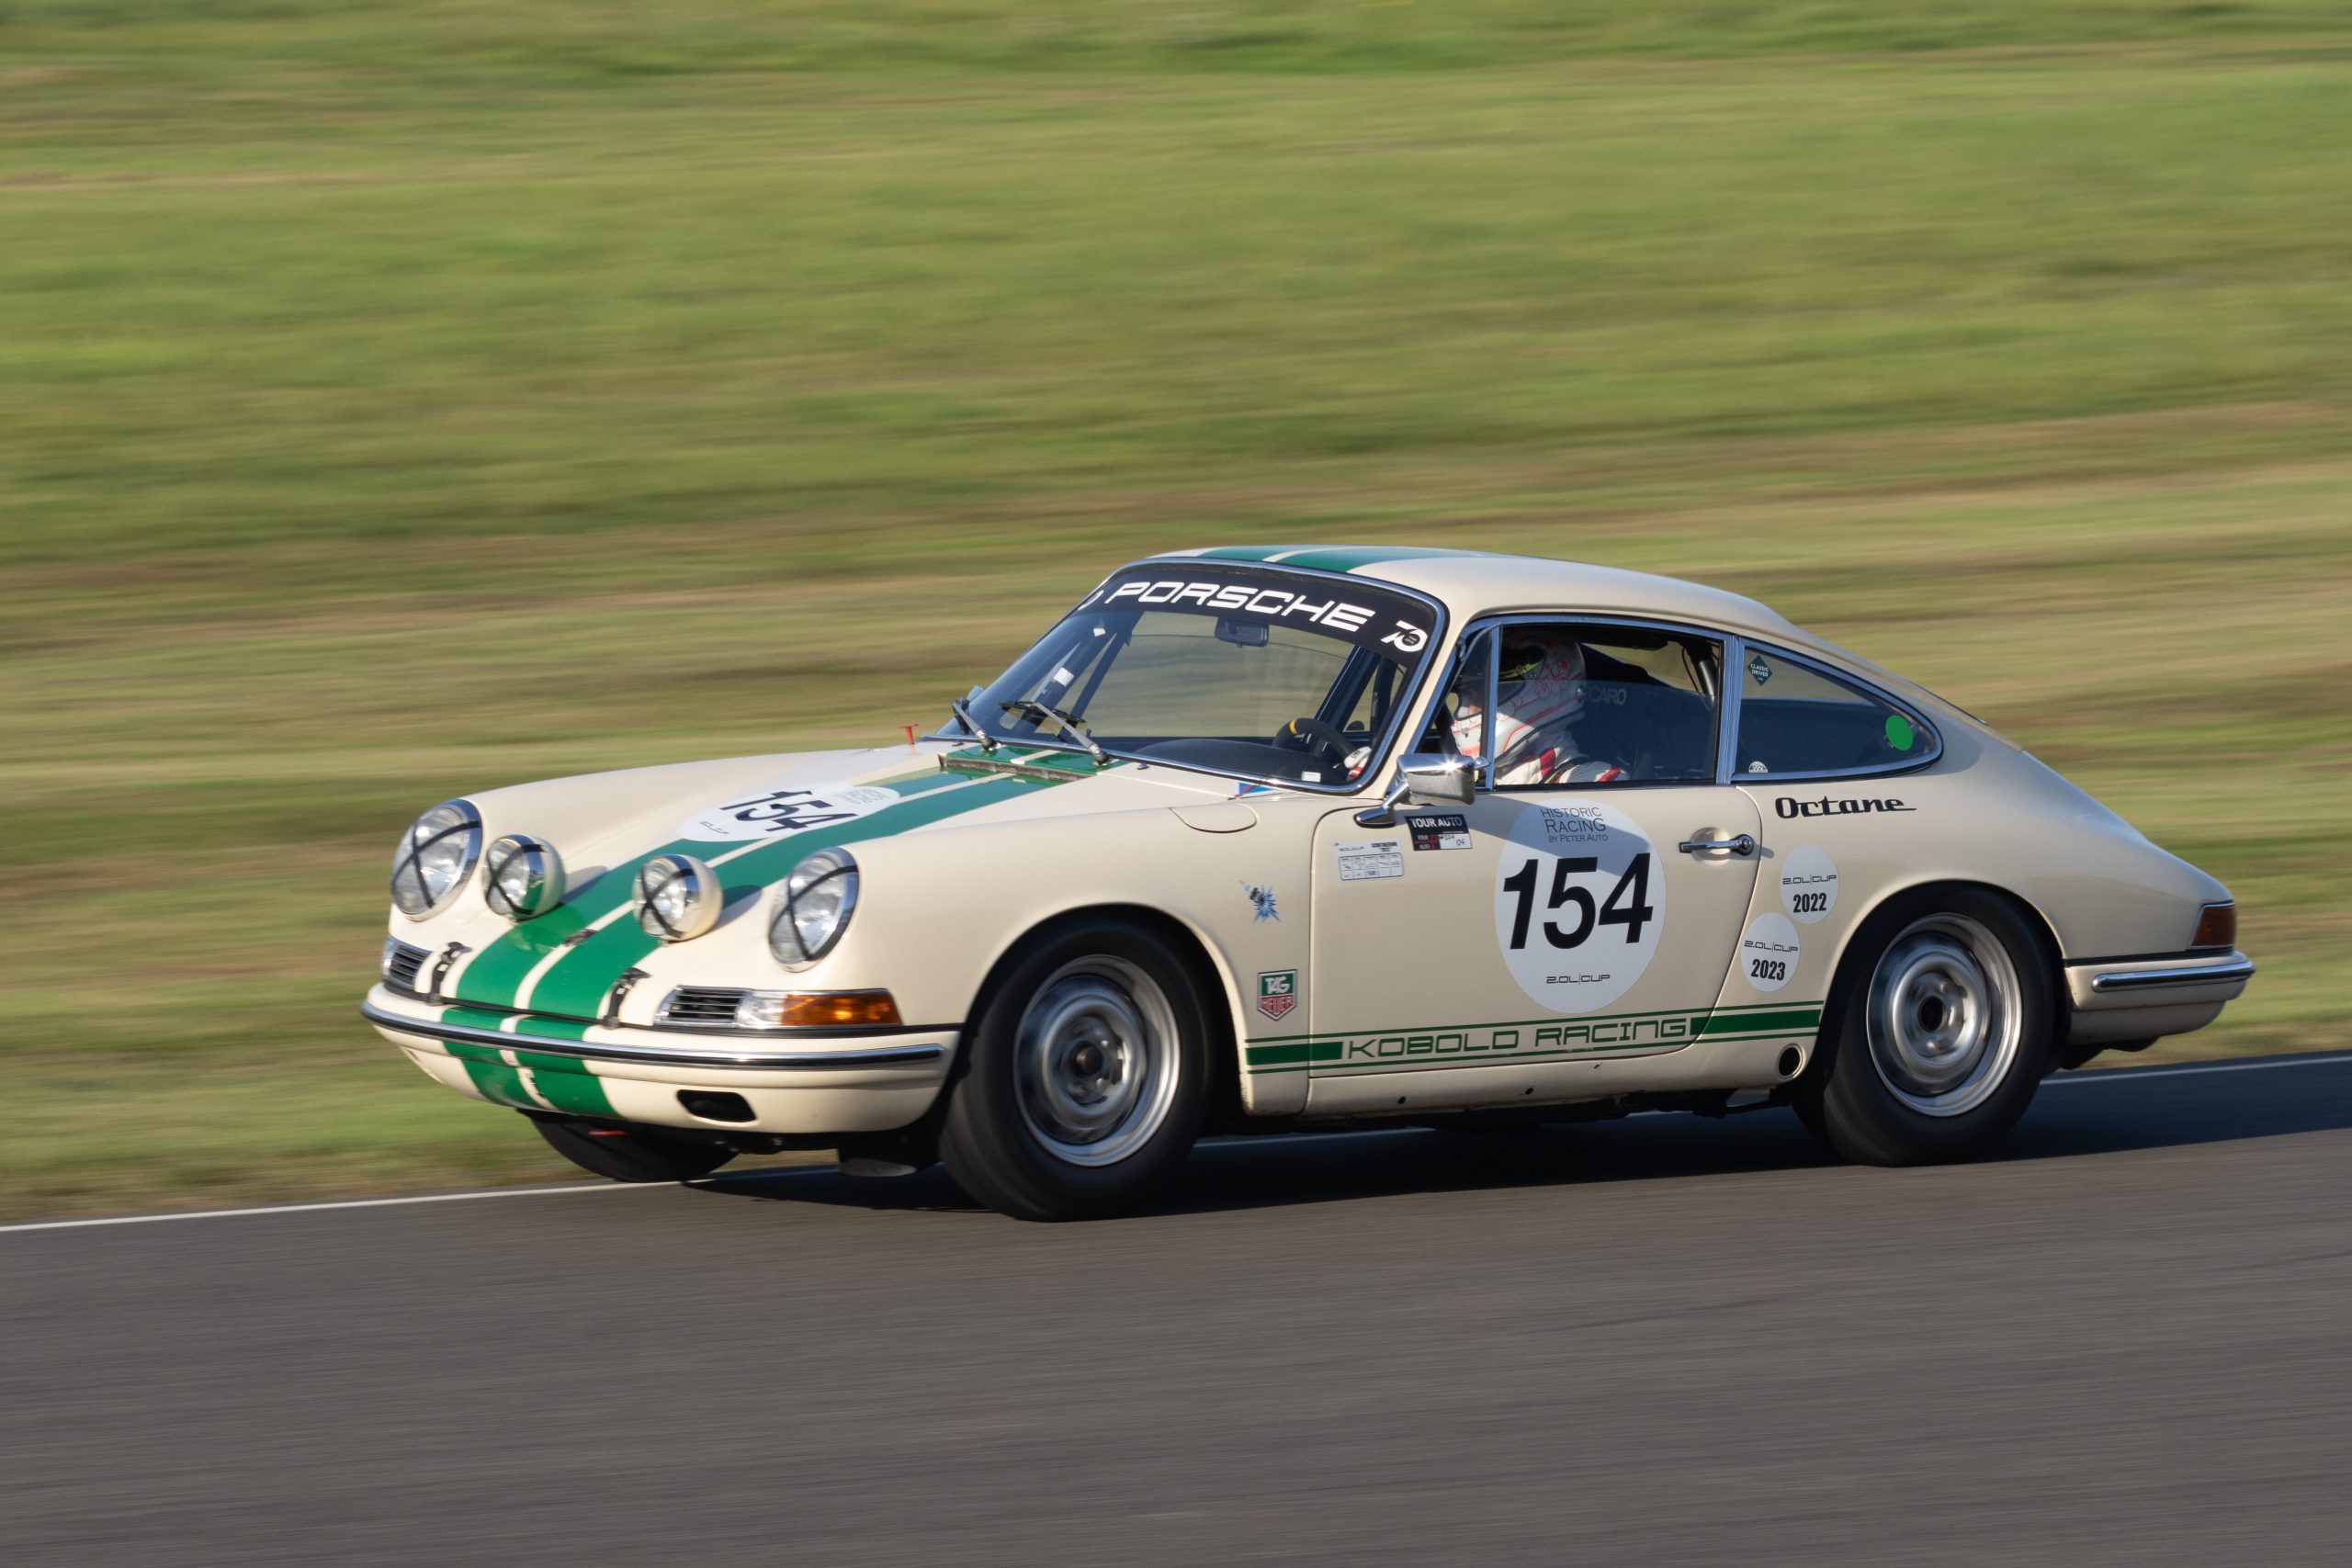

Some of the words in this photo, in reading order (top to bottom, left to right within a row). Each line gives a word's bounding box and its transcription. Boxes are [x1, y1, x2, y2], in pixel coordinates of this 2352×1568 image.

[1104, 581, 1376, 632] PORSCHE
[1750, 663, 1770, 672] CLASSIC
[1751, 669, 1769, 677] DRIVER
[719, 790, 858, 832] 154
[1540, 807, 1602, 818] HISTORIC
[1774, 795, 1917, 819] Octane
[1409, 818, 1437, 828] TOUR
[1438, 817, 1463, 827] AUTO
[1544, 818, 1607, 833] RACING
[1559, 834, 1585, 842] PETER
[1587, 833, 1609, 842] AUTO
[1502, 852, 1654, 950] 154
[1792, 893, 1827, 913] 2022
[1750, 958, 1786, 981] 2023
[1264, 976, 1291, 995] TAG
[1261, 996, 1294, 1016] HEUER
[1347, 1030, 1520, 1059] KOBOLD
[1534, 1019, 1687, 1047] RACING
